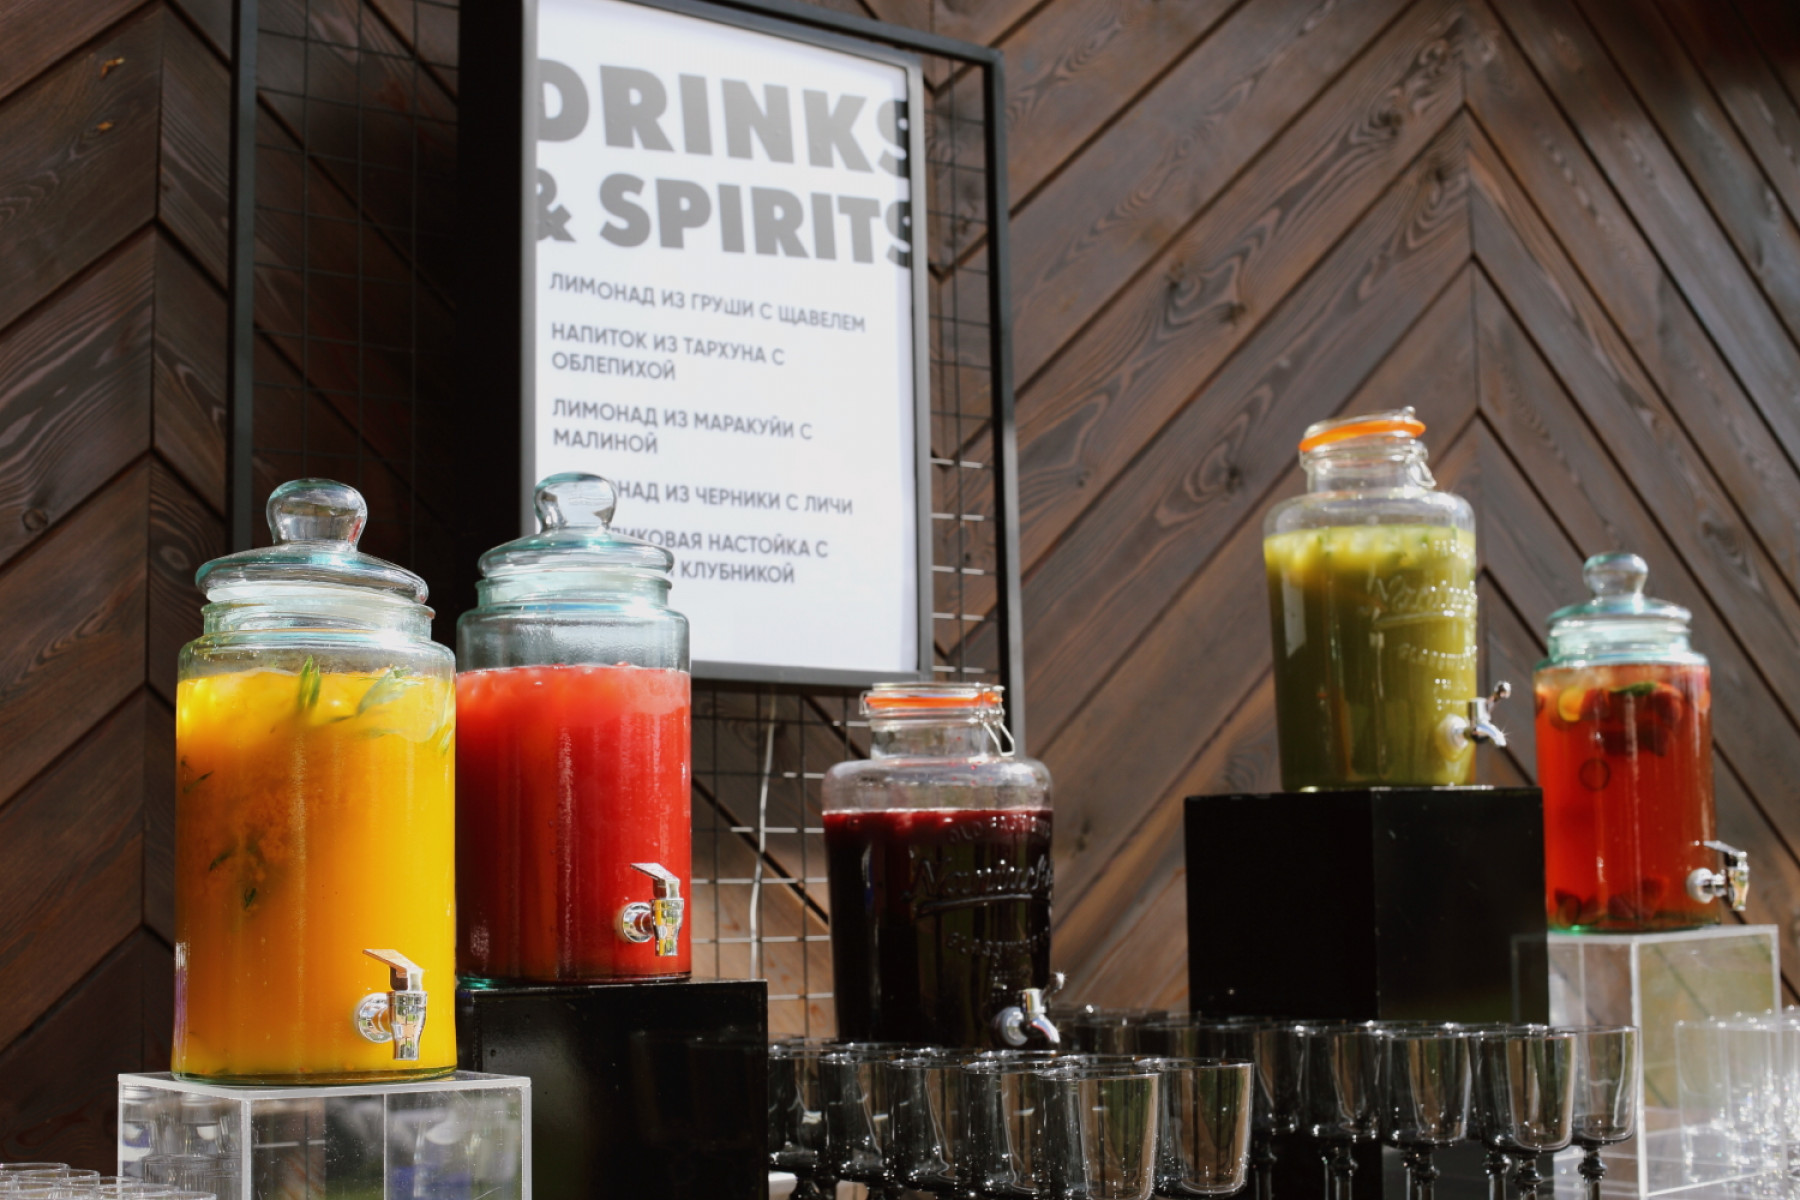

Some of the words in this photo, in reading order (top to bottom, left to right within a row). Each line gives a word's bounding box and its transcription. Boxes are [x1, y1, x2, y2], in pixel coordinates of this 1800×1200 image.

[536, 58, 910, 179] DRINKS
[549, 272, 656, 307] ЛИМОНАД
[661, 289, 686, 310] ИЗ
[691, 293, 754, 317] ГРУШИ
[759, 303, 772, 320] С
[778, 305, 865, 332] ЩАВЕЛЕМ
[551, 323, 647, 349] НАПИТОК
[653, 334, 678, 354] ИЗ
[683, 337, 767, 363] ТАРХУНА
[771, 349, 785, 366] С
[551, 352, 676, 380] ОБЛЕПИХОЙ
[552, 398, 659, 428] ЛИМОНАД
[663, 409, 689, 429] ИЗ
[693, 412, 795, 438] МАРАКУЙИ
[799, 423, 812, 440] С
[553, 428, 658, 455] МАЛИНОЙ
[665, 484, 690, 503] ИЗ
[695, 487, 781, 510] ЧЕРНИКИ
[785, 493, 799, 512] С
[804, 495, 853, 515] ЛИЧИ
[708, 533, 811, 557] НАСТОЙКА
[815, 540, 829, 559] С
[680, 561, 795, 584] КЛУБНИКОЙ
